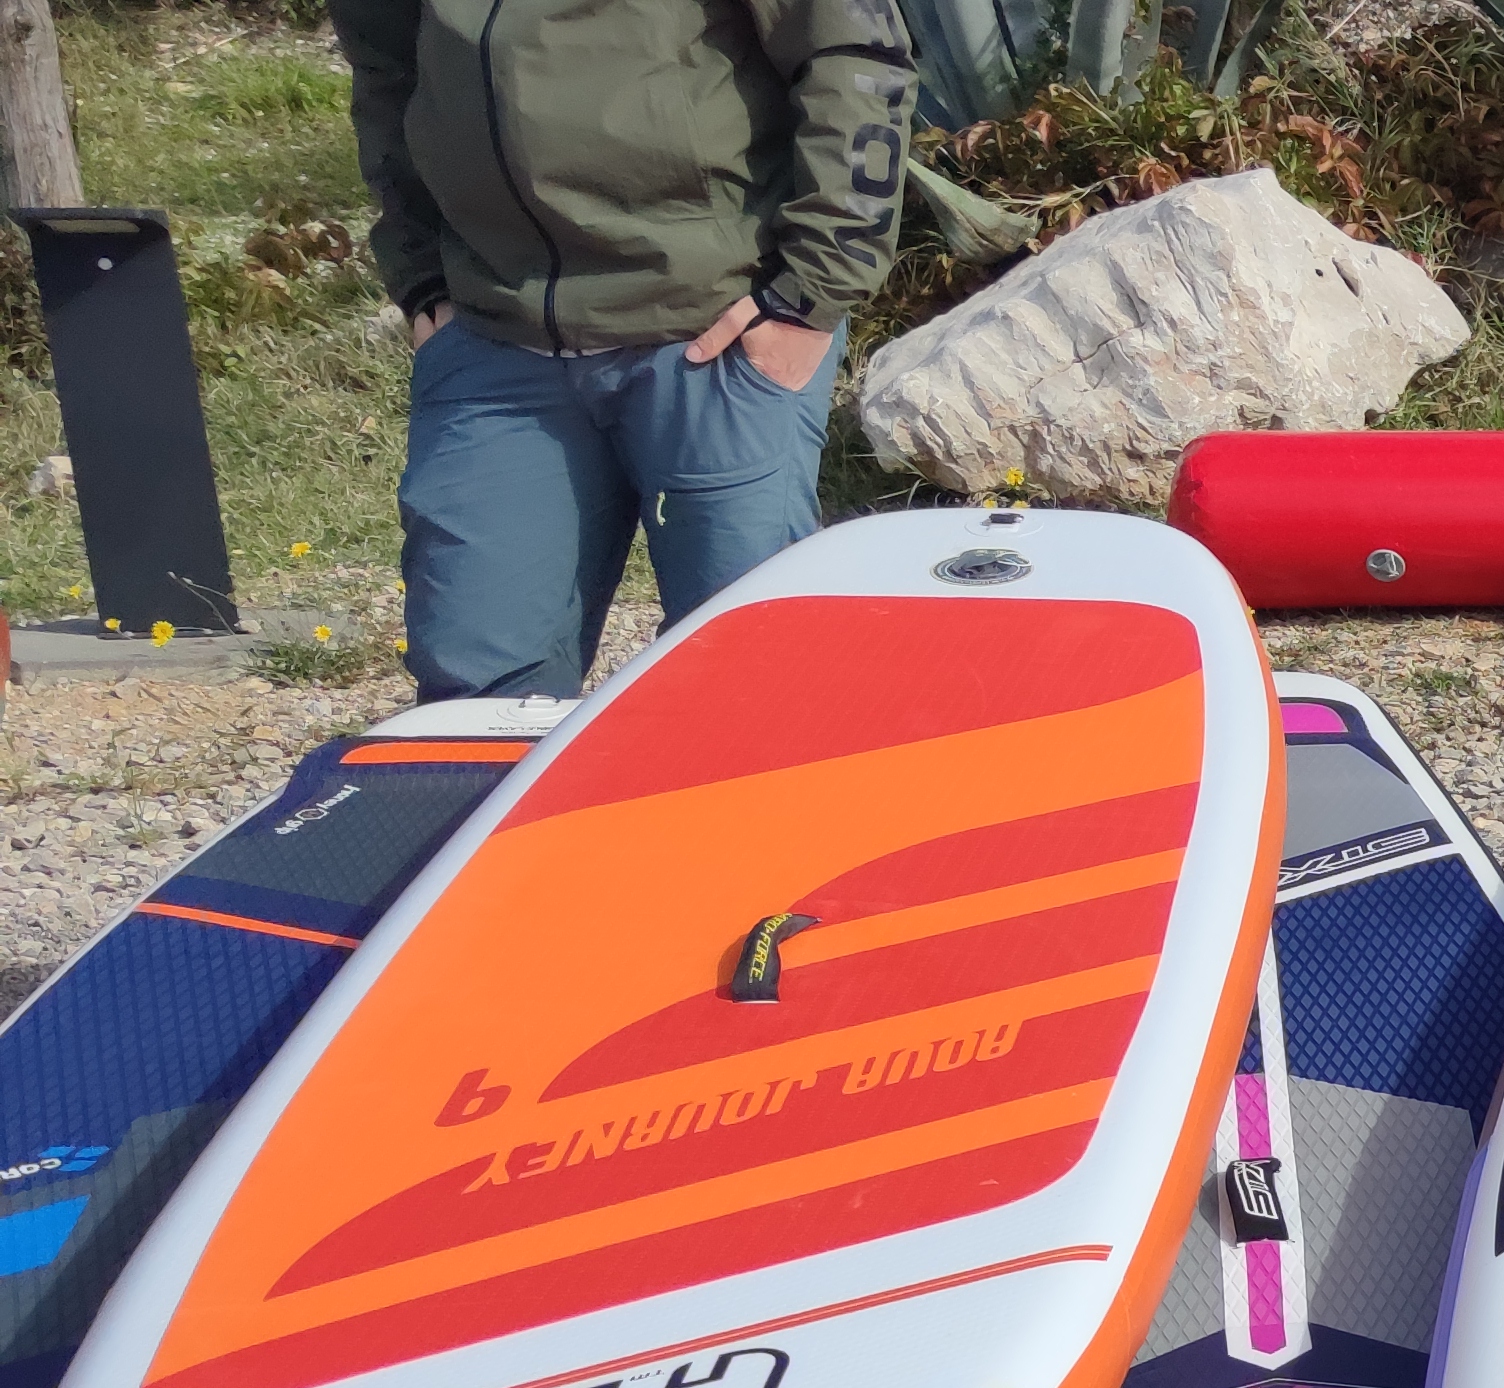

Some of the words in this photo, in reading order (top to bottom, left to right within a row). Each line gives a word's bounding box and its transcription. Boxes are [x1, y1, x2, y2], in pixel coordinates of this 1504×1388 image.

[840, 1020, 1024, 1095] AQUA
[0, 1157, 61, 1180] COR
[461, 1068, 818, 1195] JOURNEY
